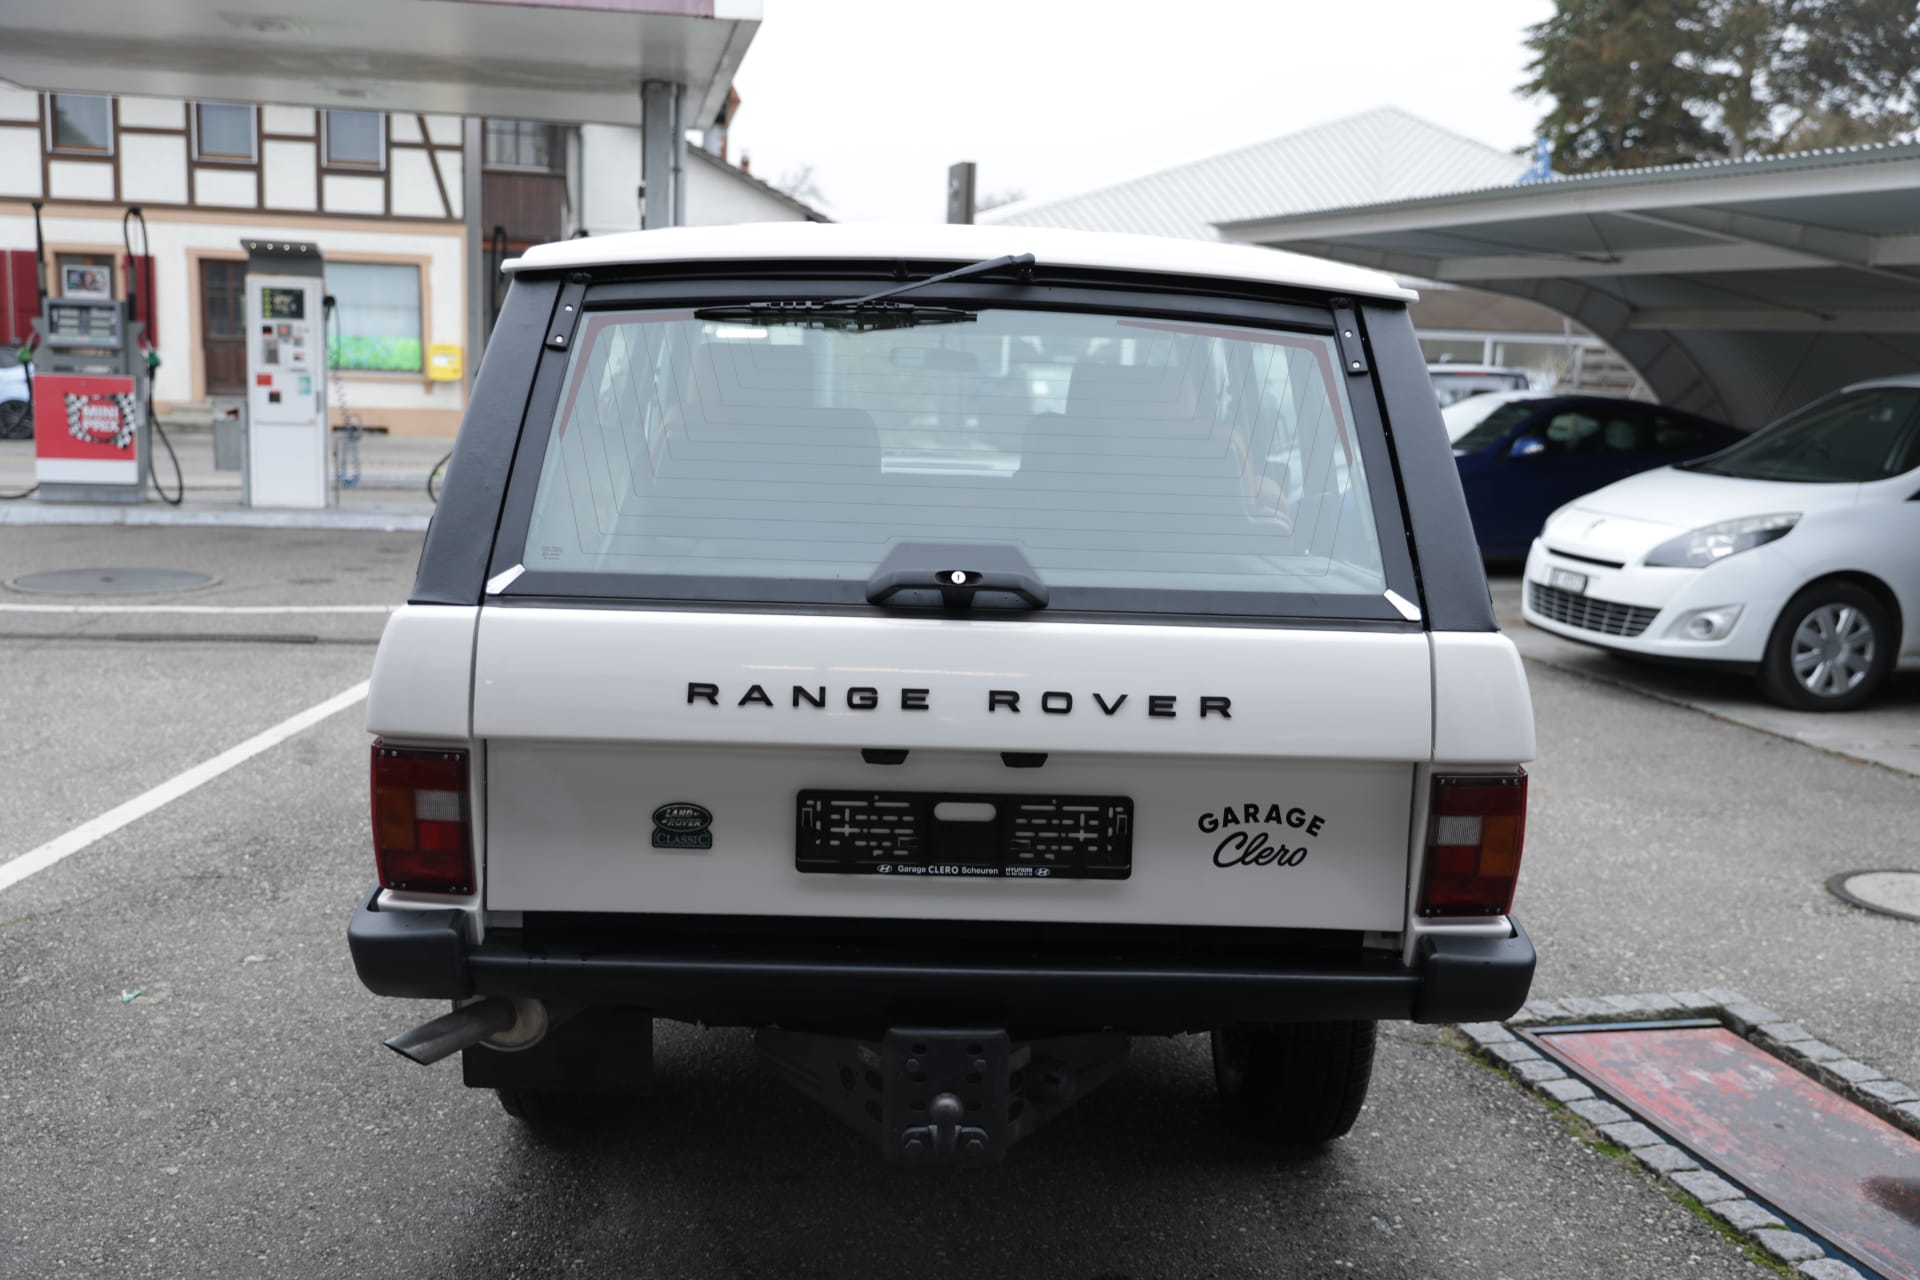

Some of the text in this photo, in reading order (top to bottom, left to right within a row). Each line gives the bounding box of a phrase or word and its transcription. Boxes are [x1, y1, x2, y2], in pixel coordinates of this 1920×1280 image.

[687, 682, 1232, 719] RANGE ROVER
[1198, 803, 1326, 838] GARAGE
[656, 833, 708, 845] CLASSIC
[1213, 831, 1308, 868] Clero
[897, 864, 926, 874] Garage
[928, 865, 959, 874] CLERO
[961, 865, 999, 875] Scheuren
